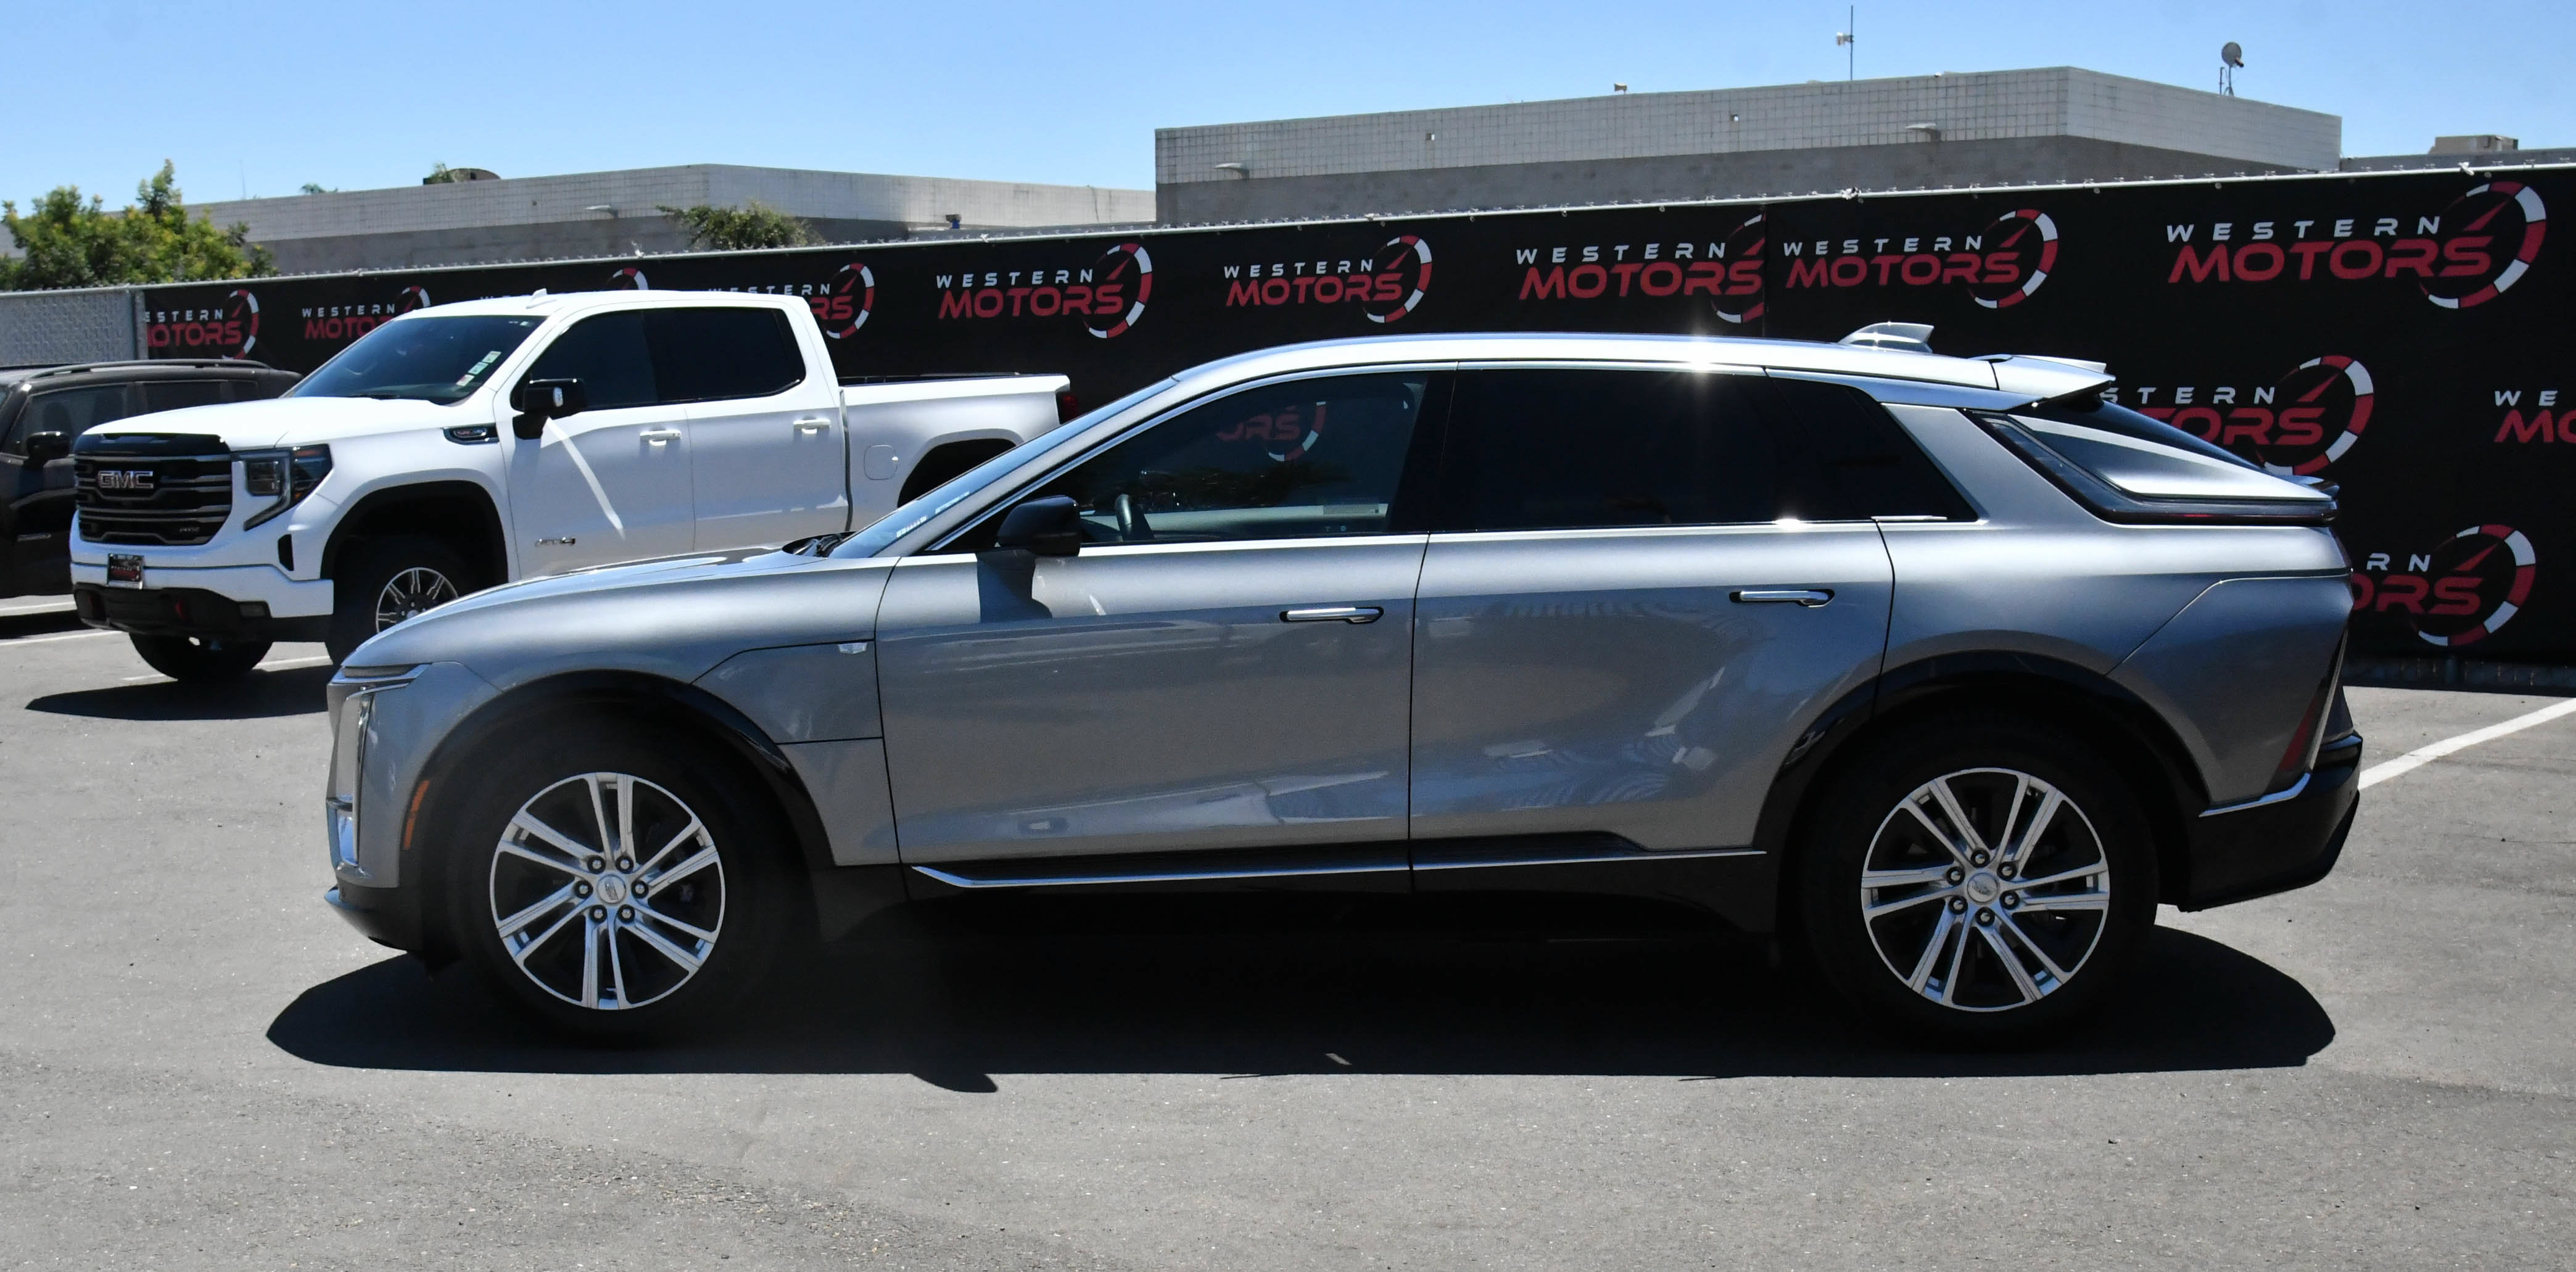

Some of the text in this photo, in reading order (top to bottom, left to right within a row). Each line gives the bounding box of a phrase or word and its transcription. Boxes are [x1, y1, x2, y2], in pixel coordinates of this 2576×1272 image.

[2166, 216, 2440, 242] WESTERN
[1516, 242, 1725, 265] WESTERN
[1783, 236, 1982, 256] WESTERN
[1224, 259, 1373, 279] WESTERN
[1786, 252, 2020, 289] MOTORS
[2168, 236, 2494, 283] MOTORS
[708, 283, 830, 295] STERN
[936, 269, 1093, 288] WESTERN
[1225, 273, 1404, 307] MOTORS
[1518, 260, 1765, 300] MOTORS
[302, 304, 395, 318] WESTERN
[938, 284, 1124, 319] MOTORS
[305, 316, 394, 339] MOTO
[98, 470, 154, 489] GMC
